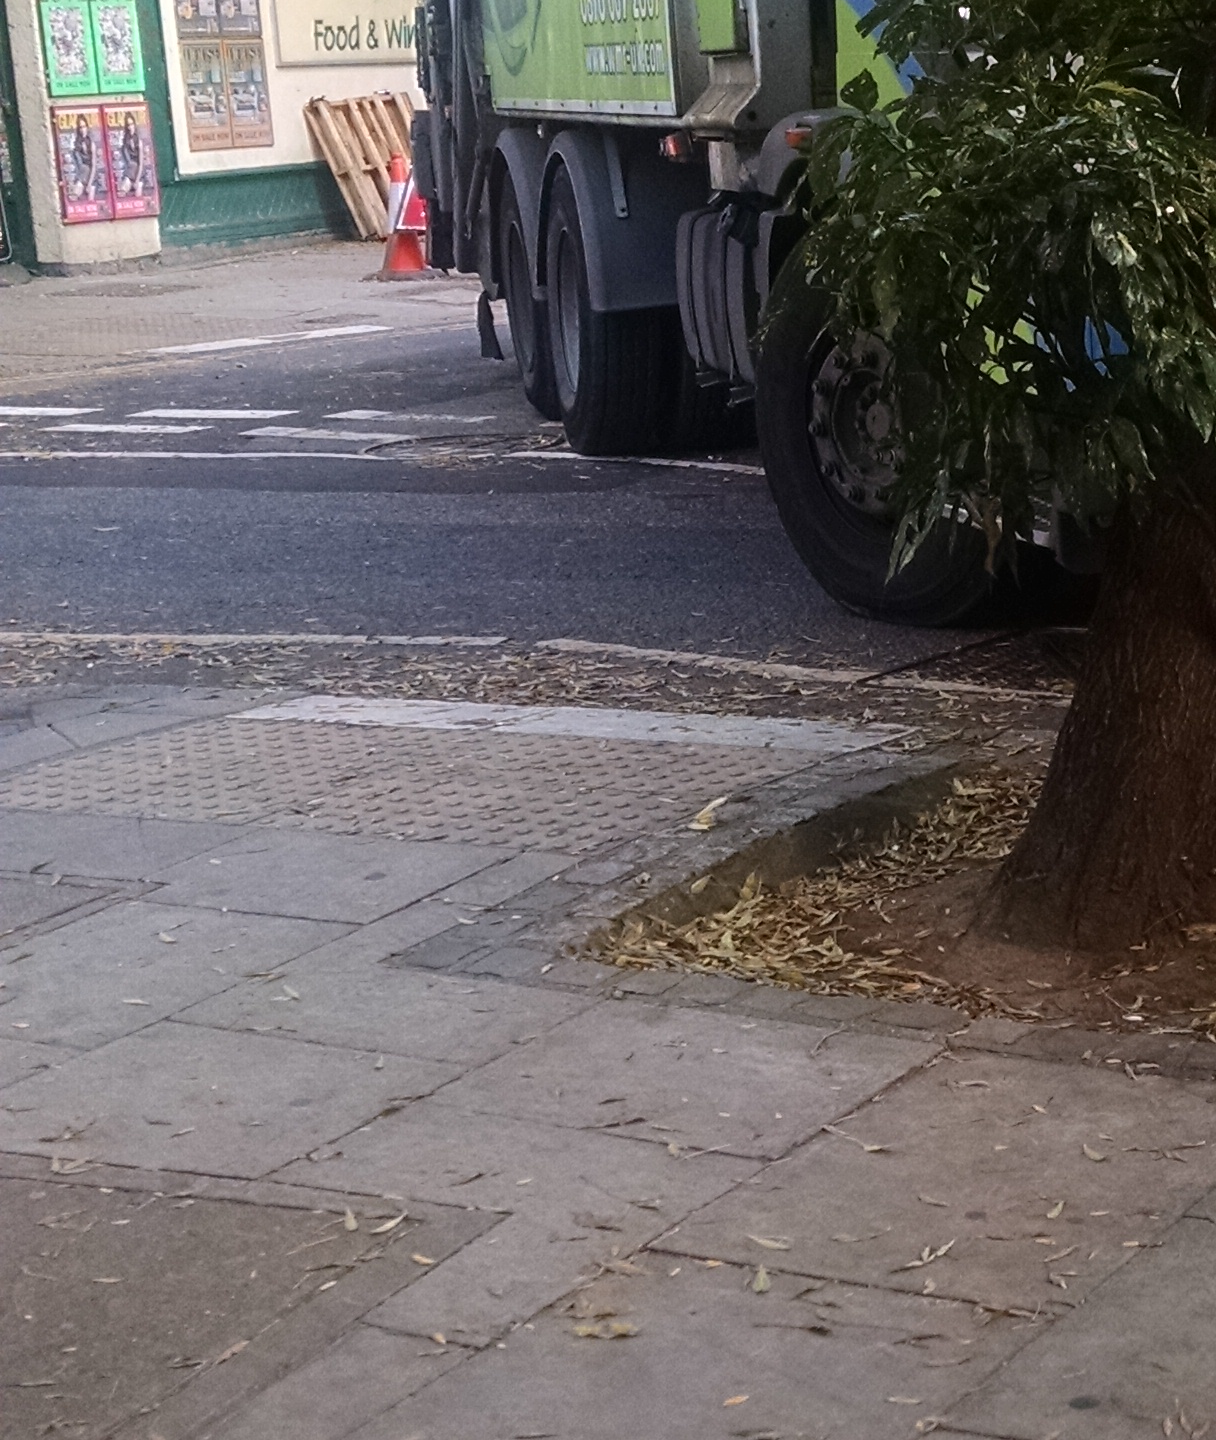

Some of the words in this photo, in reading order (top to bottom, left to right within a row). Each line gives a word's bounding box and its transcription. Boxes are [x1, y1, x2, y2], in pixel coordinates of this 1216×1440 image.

[314, 15, 360, 51] Food
[366, 19, 379, 50] &
[384, 15, 417, 49] Win
